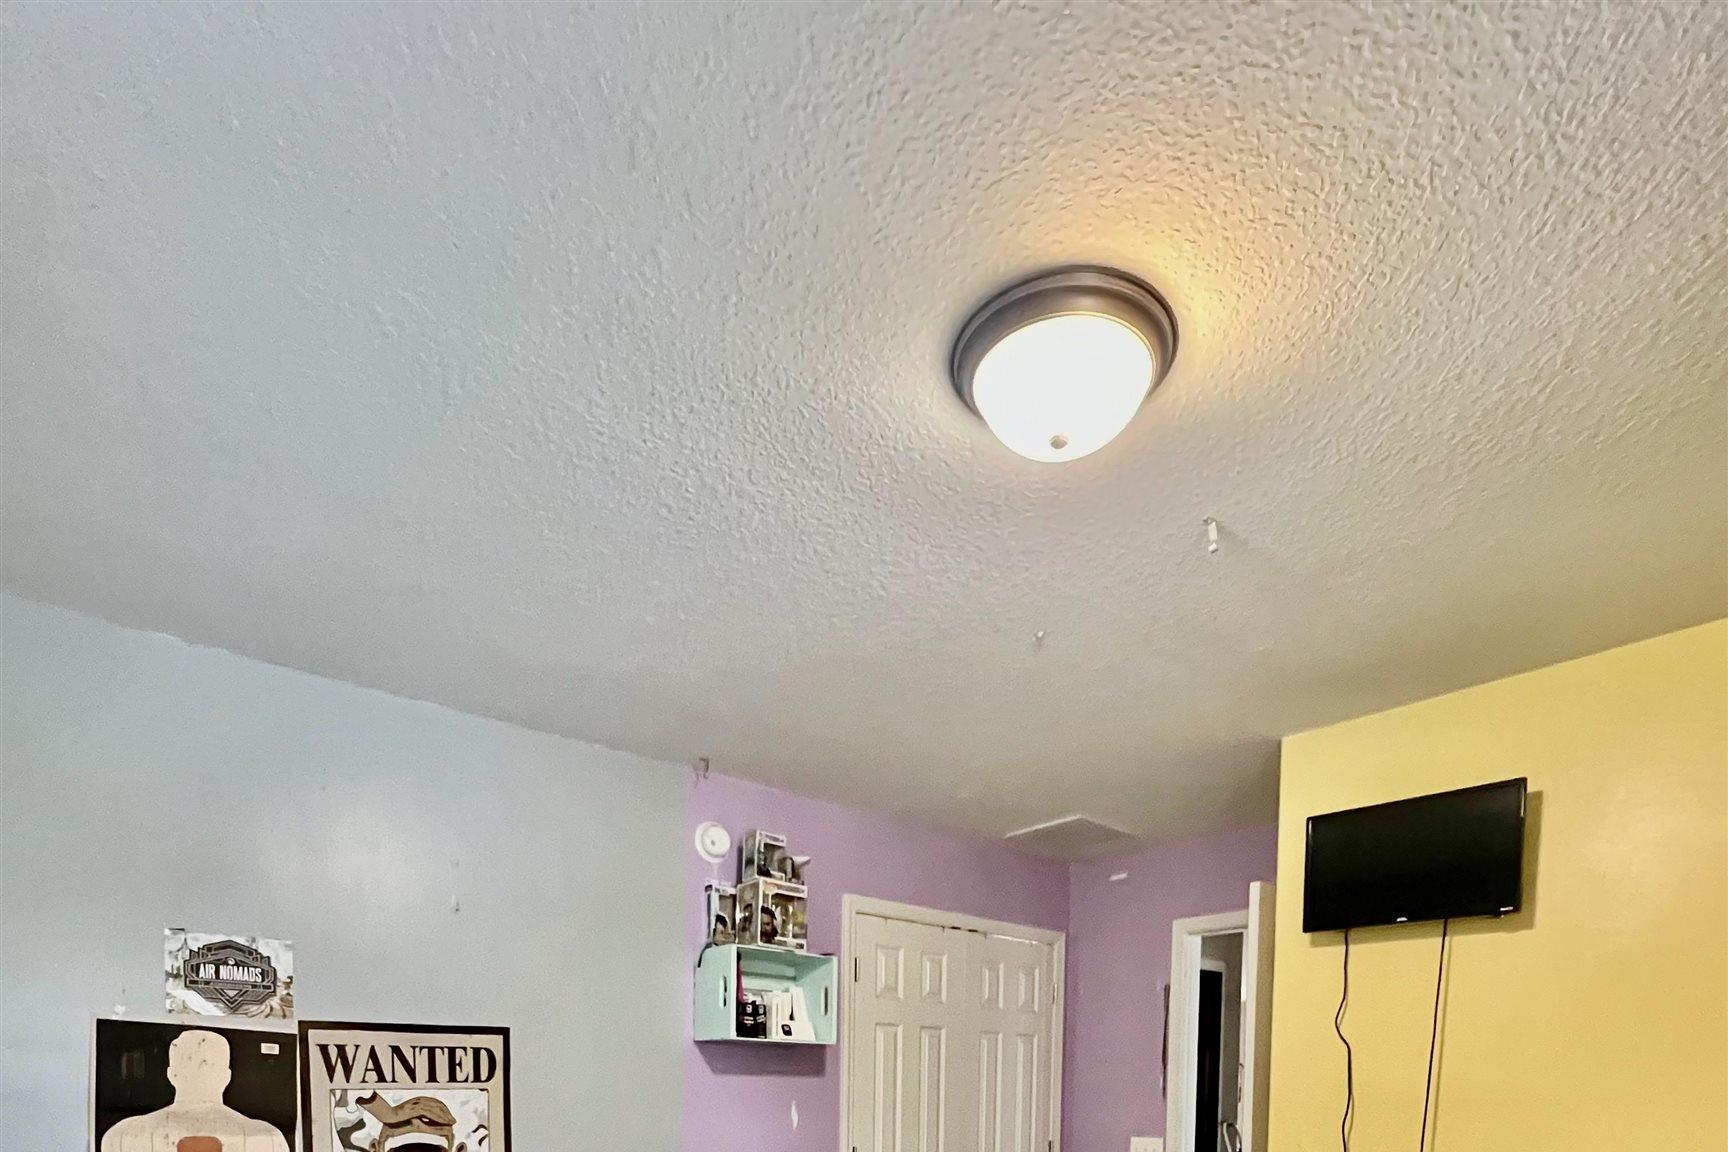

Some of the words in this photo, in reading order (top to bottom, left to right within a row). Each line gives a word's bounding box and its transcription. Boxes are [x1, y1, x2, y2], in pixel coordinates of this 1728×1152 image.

[199, 963, 216, 979] AIR
[219, 964, 262, 982] NOMADS
[316, 1043, 497, 1084] WANTED
